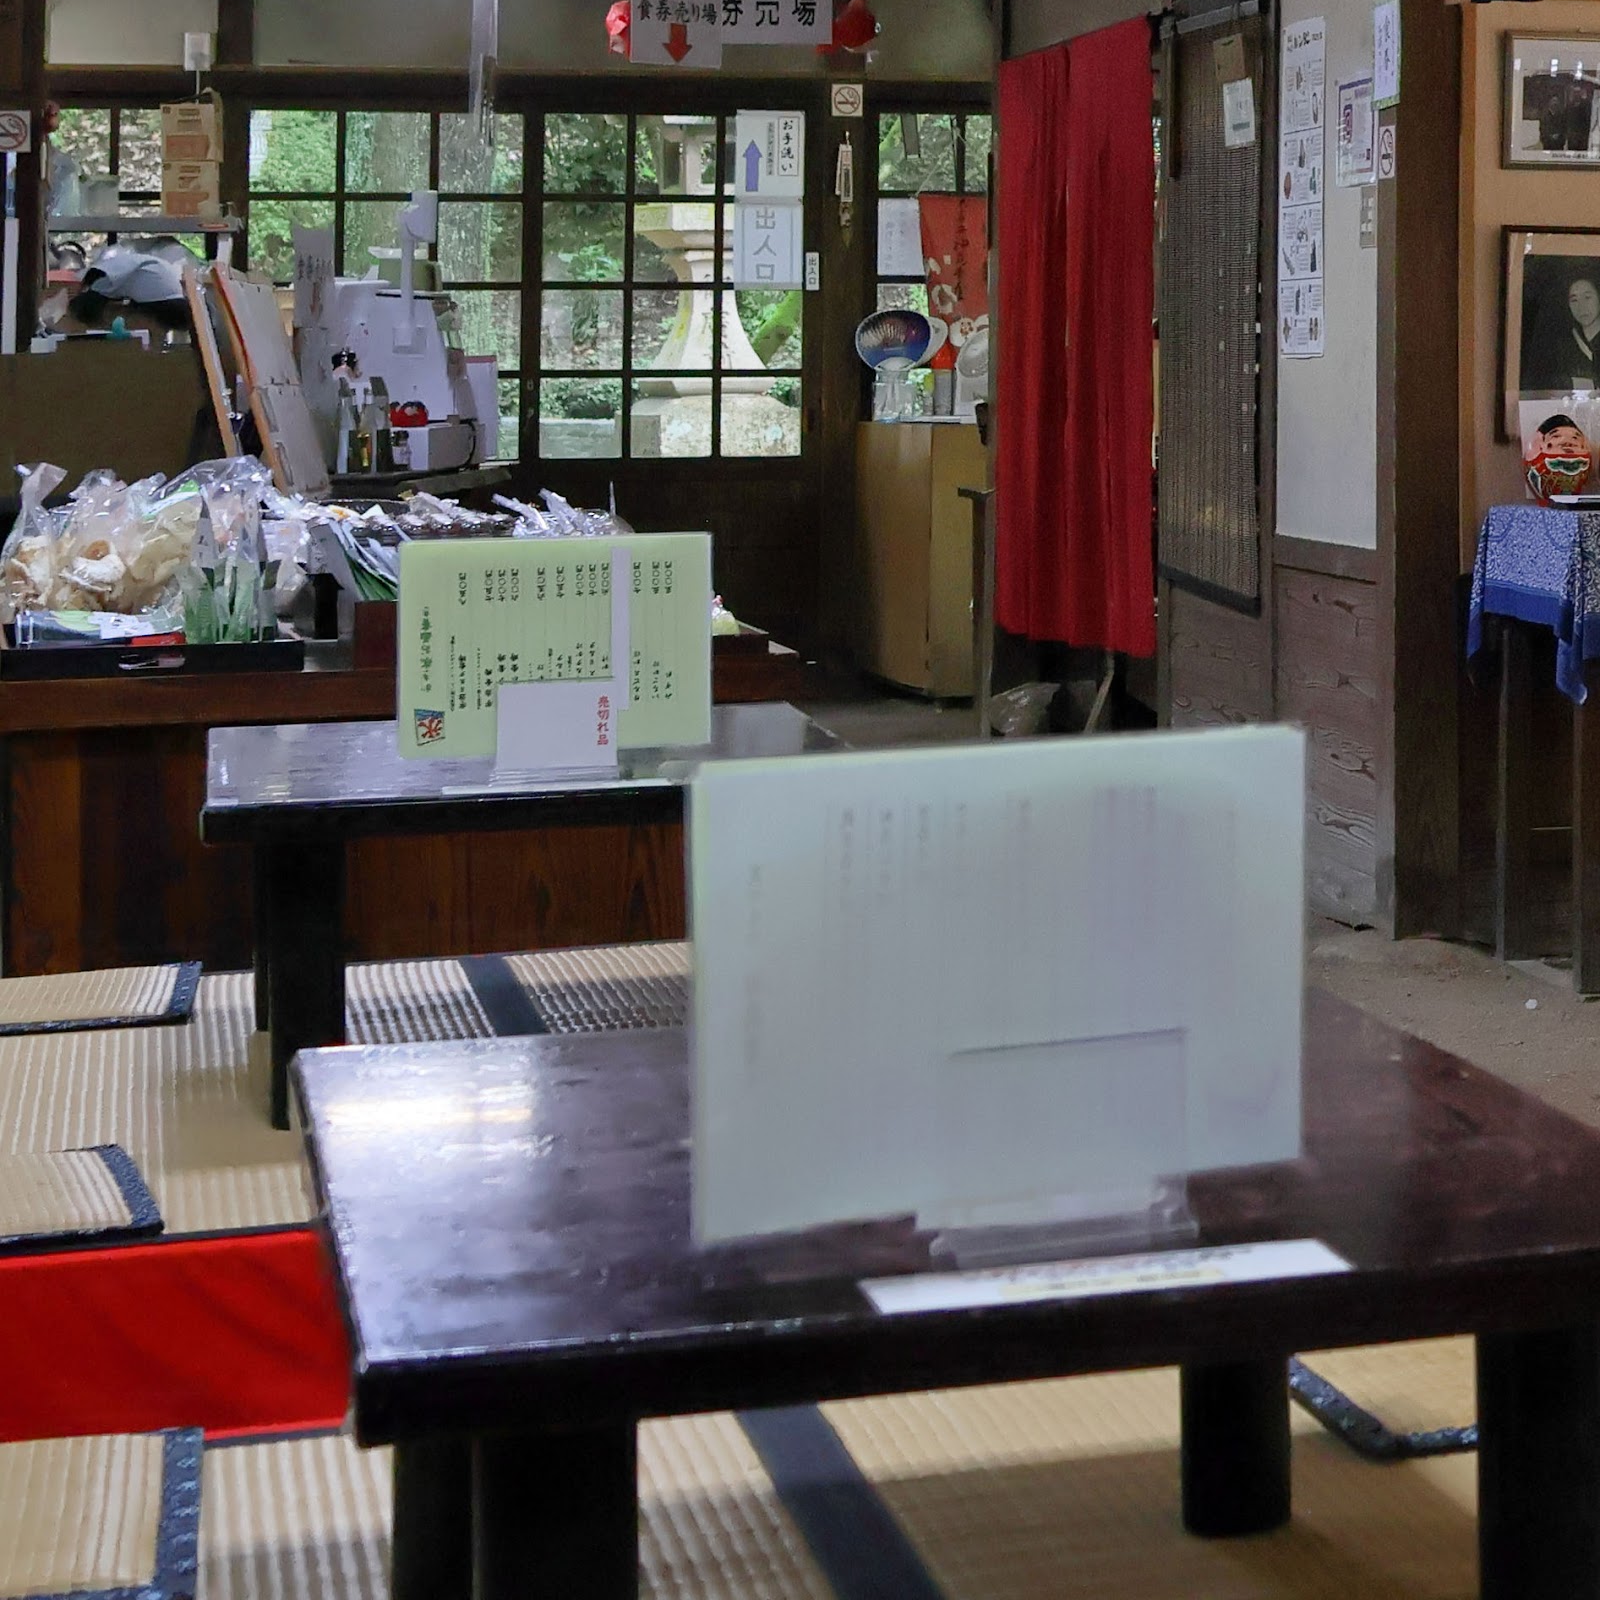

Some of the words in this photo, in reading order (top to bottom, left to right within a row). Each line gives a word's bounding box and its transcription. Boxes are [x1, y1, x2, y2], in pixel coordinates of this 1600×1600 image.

[781, 119, 795, 172] お手洗い
[497, 569, 507, 602] 七〇〇円
[576, 564, 585, 597] 七〇〇円
[589, 564, 597, 596] 七〇〇円
[633, 562, 642, 594] 七〇〇円
[417, 716, 443, 739] 氷
[597, 695, 610, 745] 売切れ品
